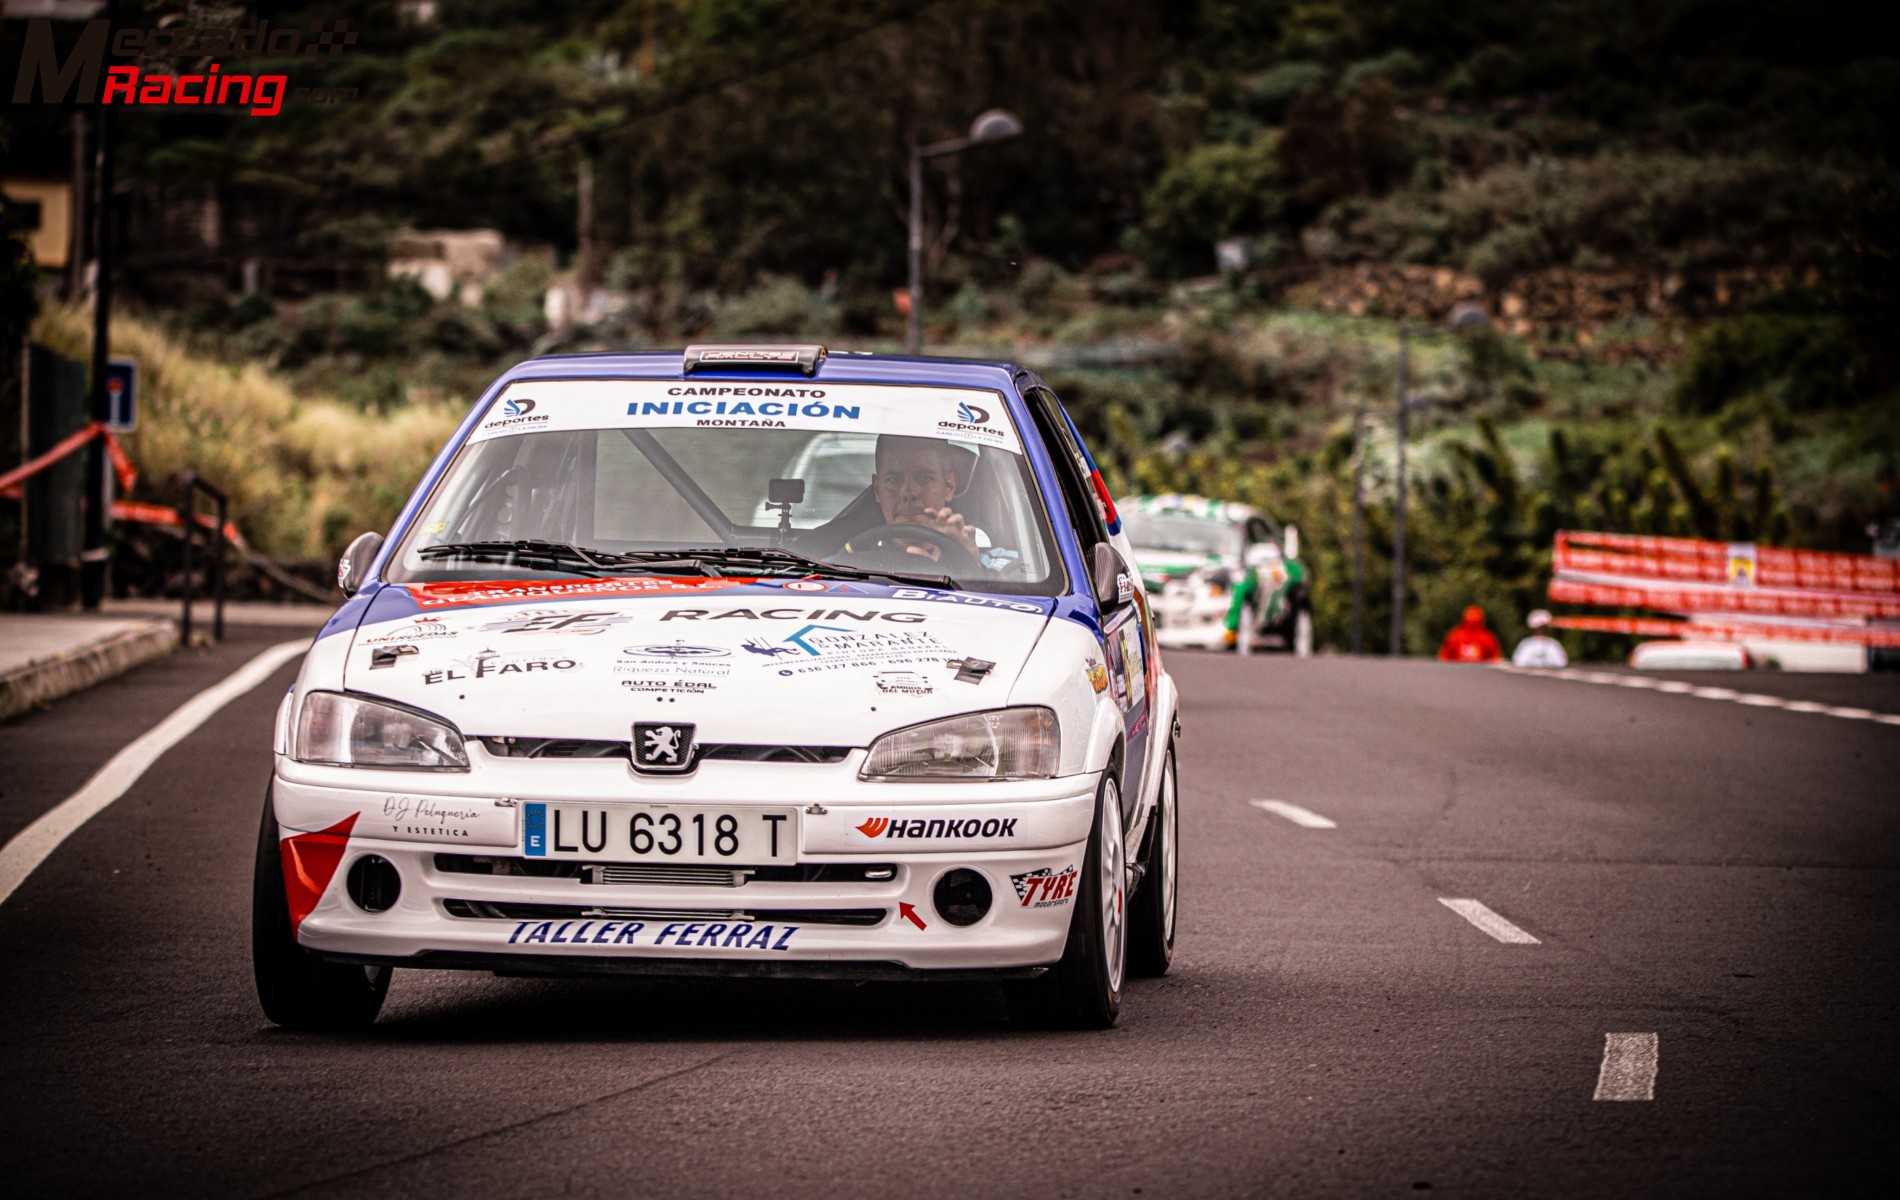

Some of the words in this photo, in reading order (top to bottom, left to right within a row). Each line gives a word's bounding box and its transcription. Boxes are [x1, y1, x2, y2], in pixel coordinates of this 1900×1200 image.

[667, 386, 827, 400] CAMPEONATO
[626, 400, 861, 421] INICIACIÓN
[484, 414, 550, 429] deportes
[696, 418, 787, 429] MONTAÑA
[938, 421, 1005, 437] deportes
[660, 608, 927, 623] RACING
[425, 670, 466, 685] EL
[475, 658, 577, 679] FARO
[675, 667, 731, 676] Natural
[407, 826, 469, 837] ESTETICA
[554, 809, 607, 853] LU
[629, 812, 739, 856] 6318
[762, 814, 788, 857] T
[530, 835, 541, 847] E
[1021, 870, 1078, 907] TYRE
[508, 921, 644, 945] TALLER
[654, 922, 800, 950] FERRAZ
